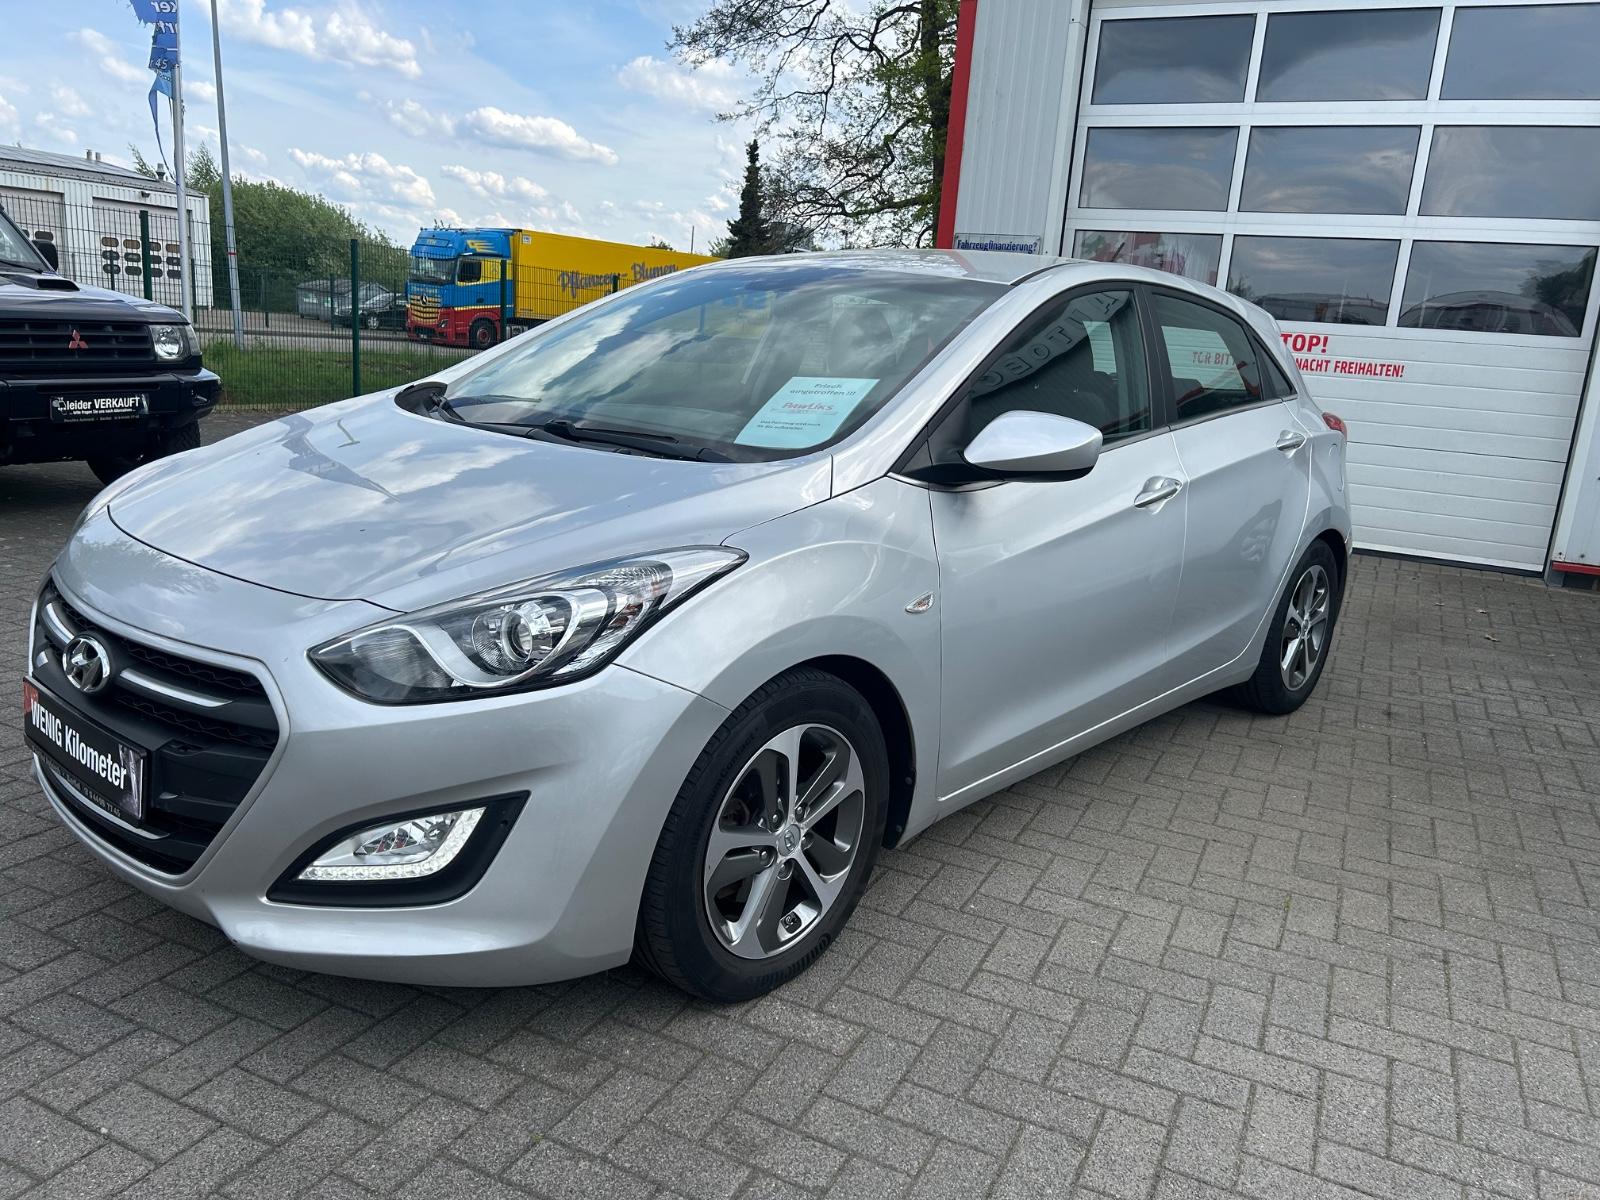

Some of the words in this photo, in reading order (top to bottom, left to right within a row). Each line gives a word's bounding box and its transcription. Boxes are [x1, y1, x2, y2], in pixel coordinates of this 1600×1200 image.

[957, 239, 1038, 255] Fahrzeugfinanzierung?
[1280, 333, 1329, 354] TOP!
[1333, 360, 1405, 378] FREIHALTEN!
[94, 396, 141, 409] VERKAUFT
[30, 697, 63, 748] WENIG
[65, 724, 127, 790] Kilometer
